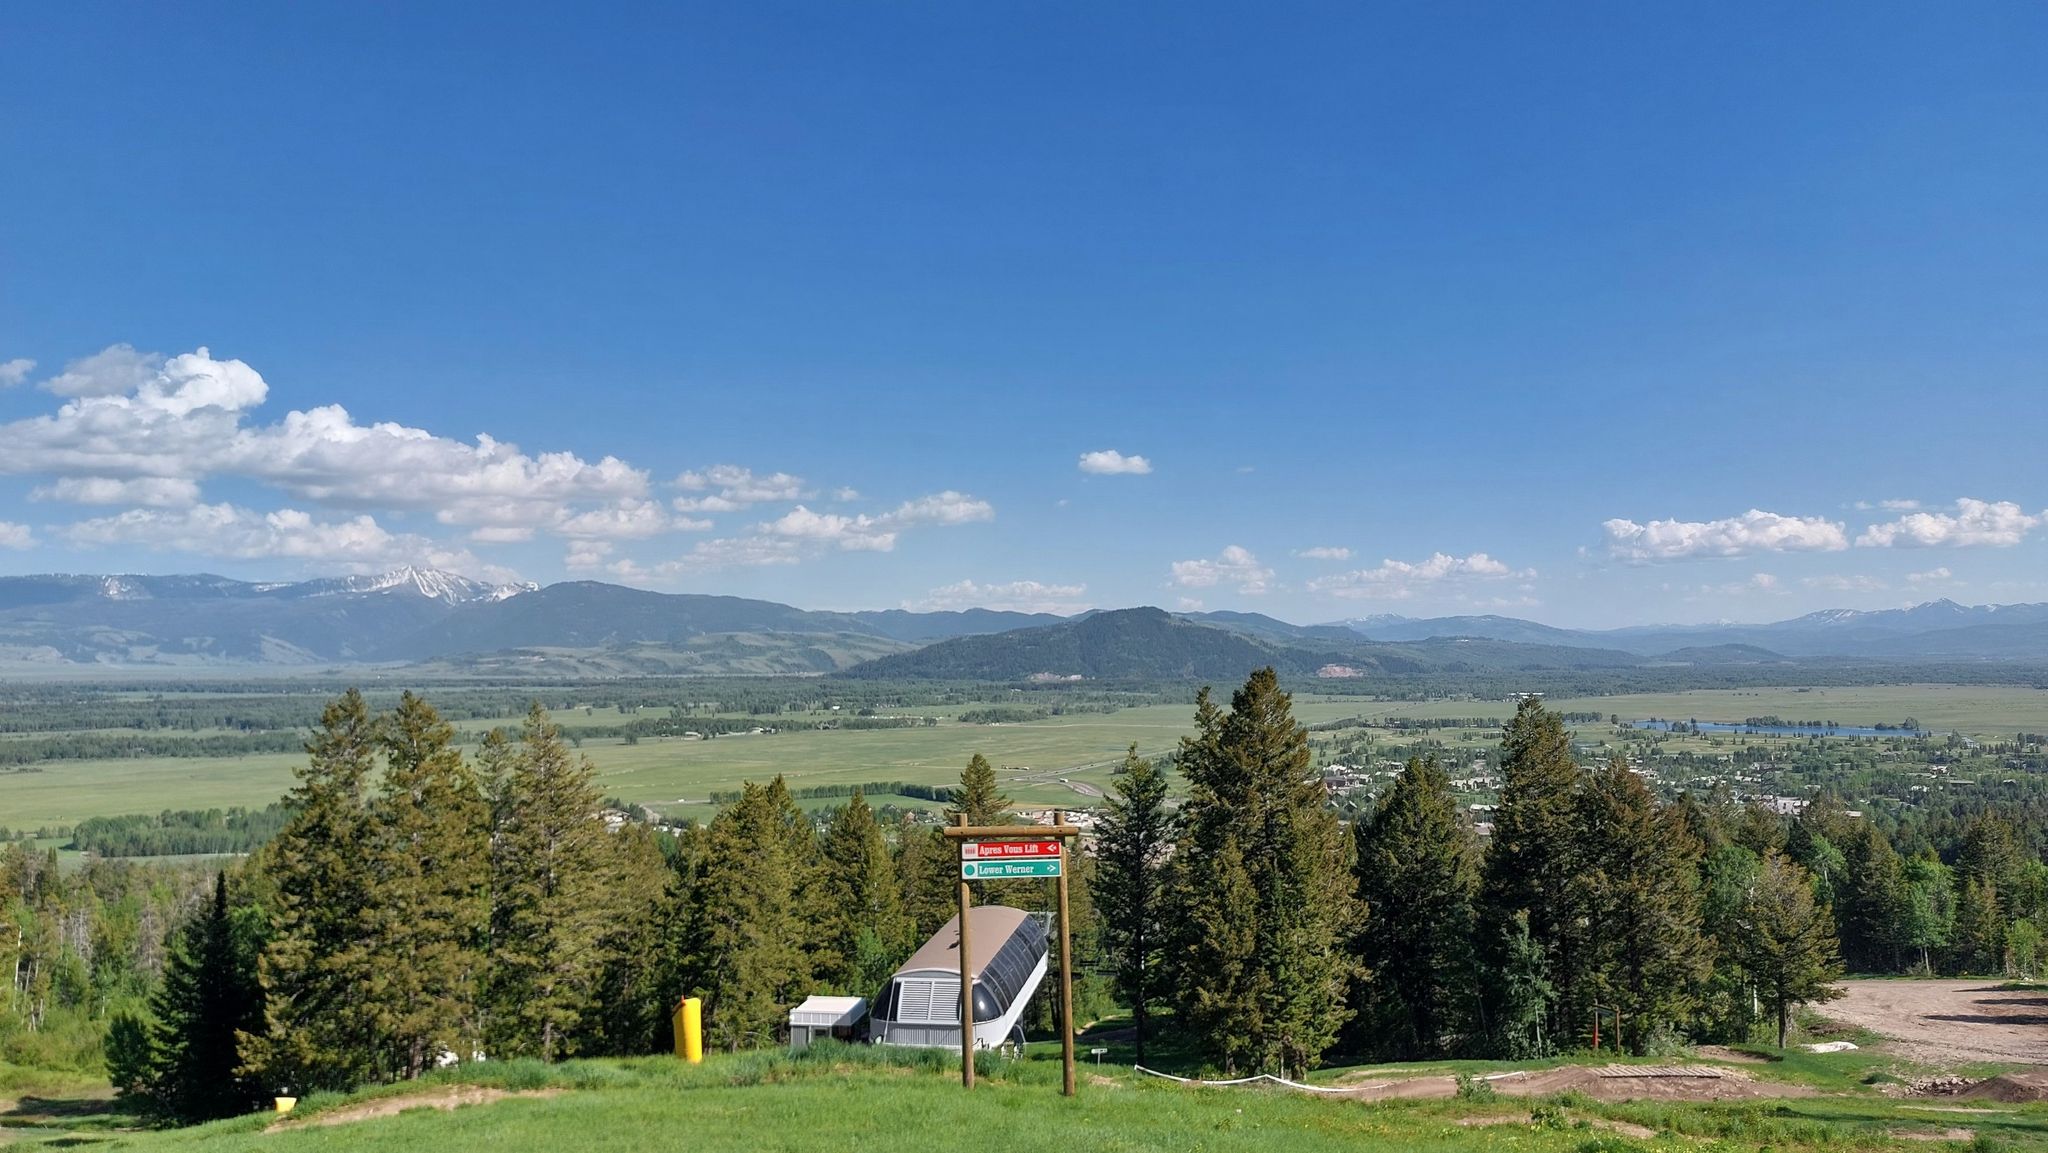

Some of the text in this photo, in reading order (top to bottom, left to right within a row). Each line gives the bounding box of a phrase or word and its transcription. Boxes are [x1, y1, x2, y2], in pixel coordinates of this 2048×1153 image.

[1003, 845, 1023, 854] Vous
[1024, 844, 1039, 853] Lift
[979, 864, 1034, 875] Lower Werner
